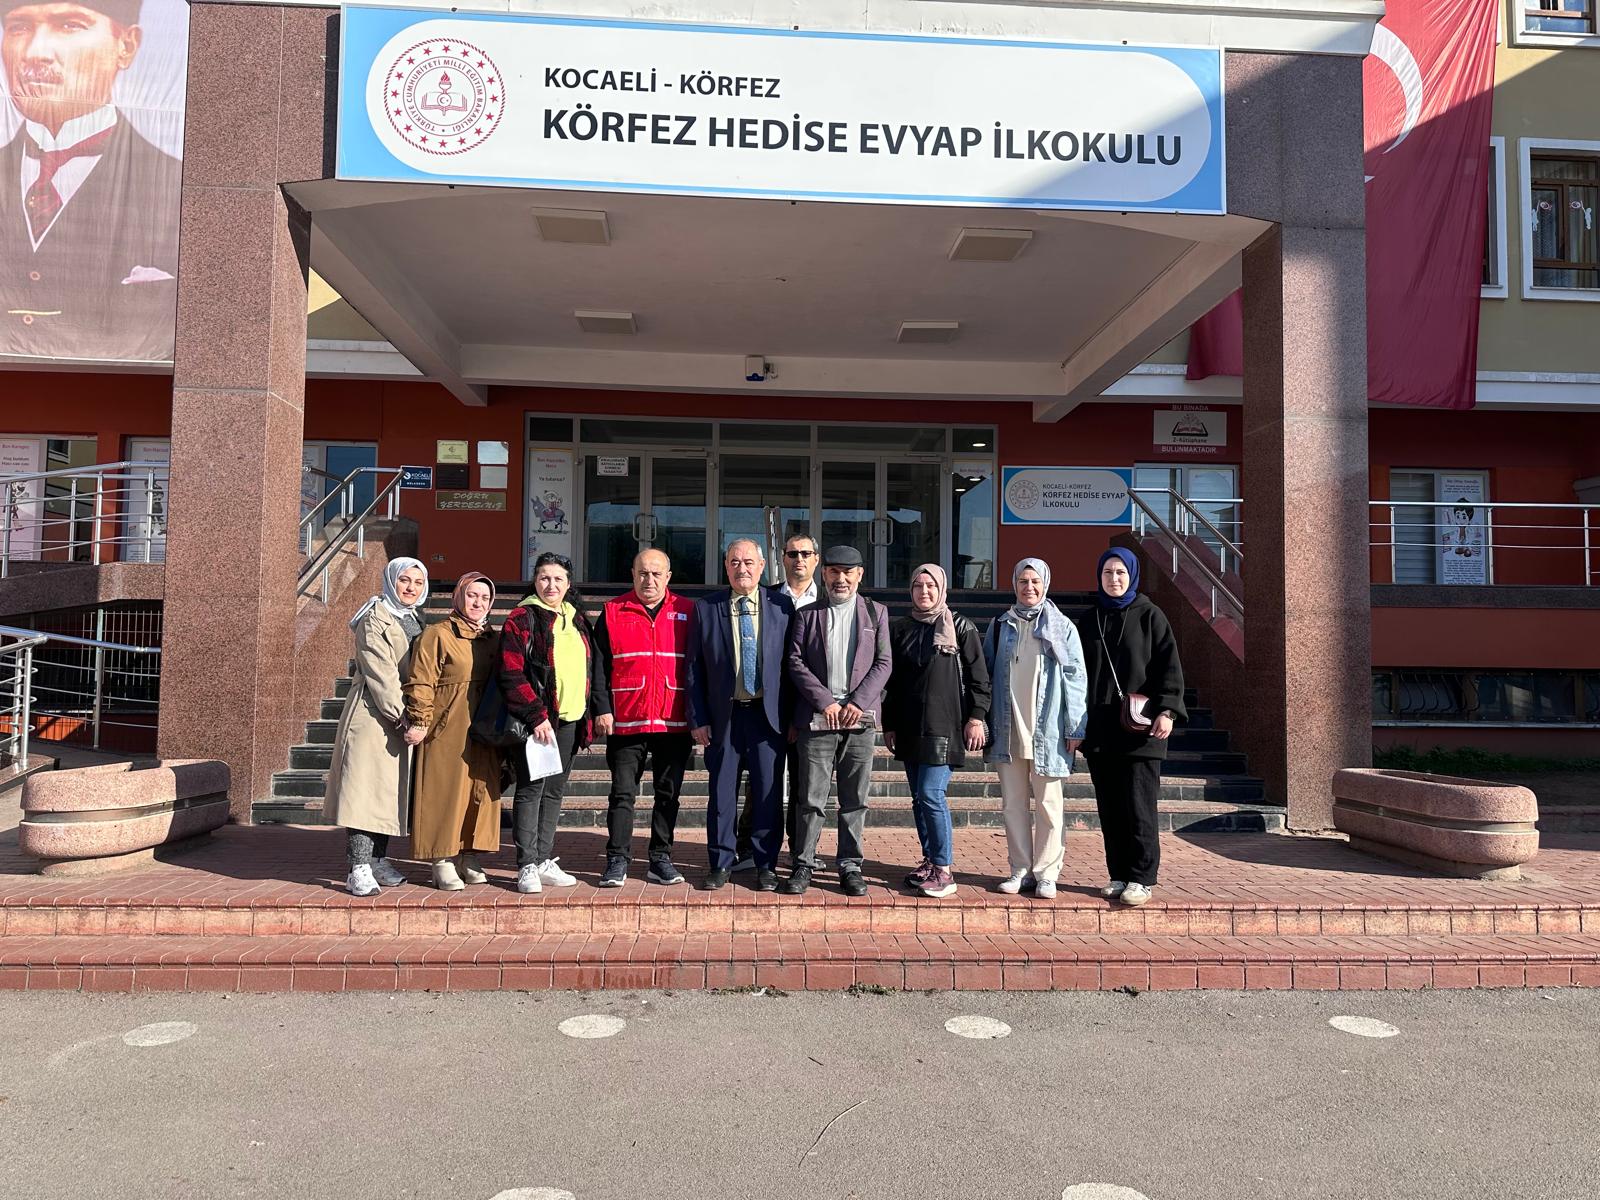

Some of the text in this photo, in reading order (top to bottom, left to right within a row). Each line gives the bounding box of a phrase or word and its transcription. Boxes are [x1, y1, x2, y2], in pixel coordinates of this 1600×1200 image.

[407, 59, 441, 103] CUMHURİYETİ
[466, 69, 484, 96] EĞİTİM
[545, 67, 657, 92] KOCAELİ
[680, 70, 781, 98] KÖRFEZ
[452, 98, 485, 133] BAKANLIĞI
[544, 103, 1181, 165] KÖRFEZ HEDİSE EVYAP İLKOKULU
[1161, 445, 1217, 453] BULUNMAKTADIR
[1042, 500, 1080, 508] İLKOKULU
[1073, 491, 1101, 499] HEDİSE
[1101, 492, 1126, 500] EVYAP
